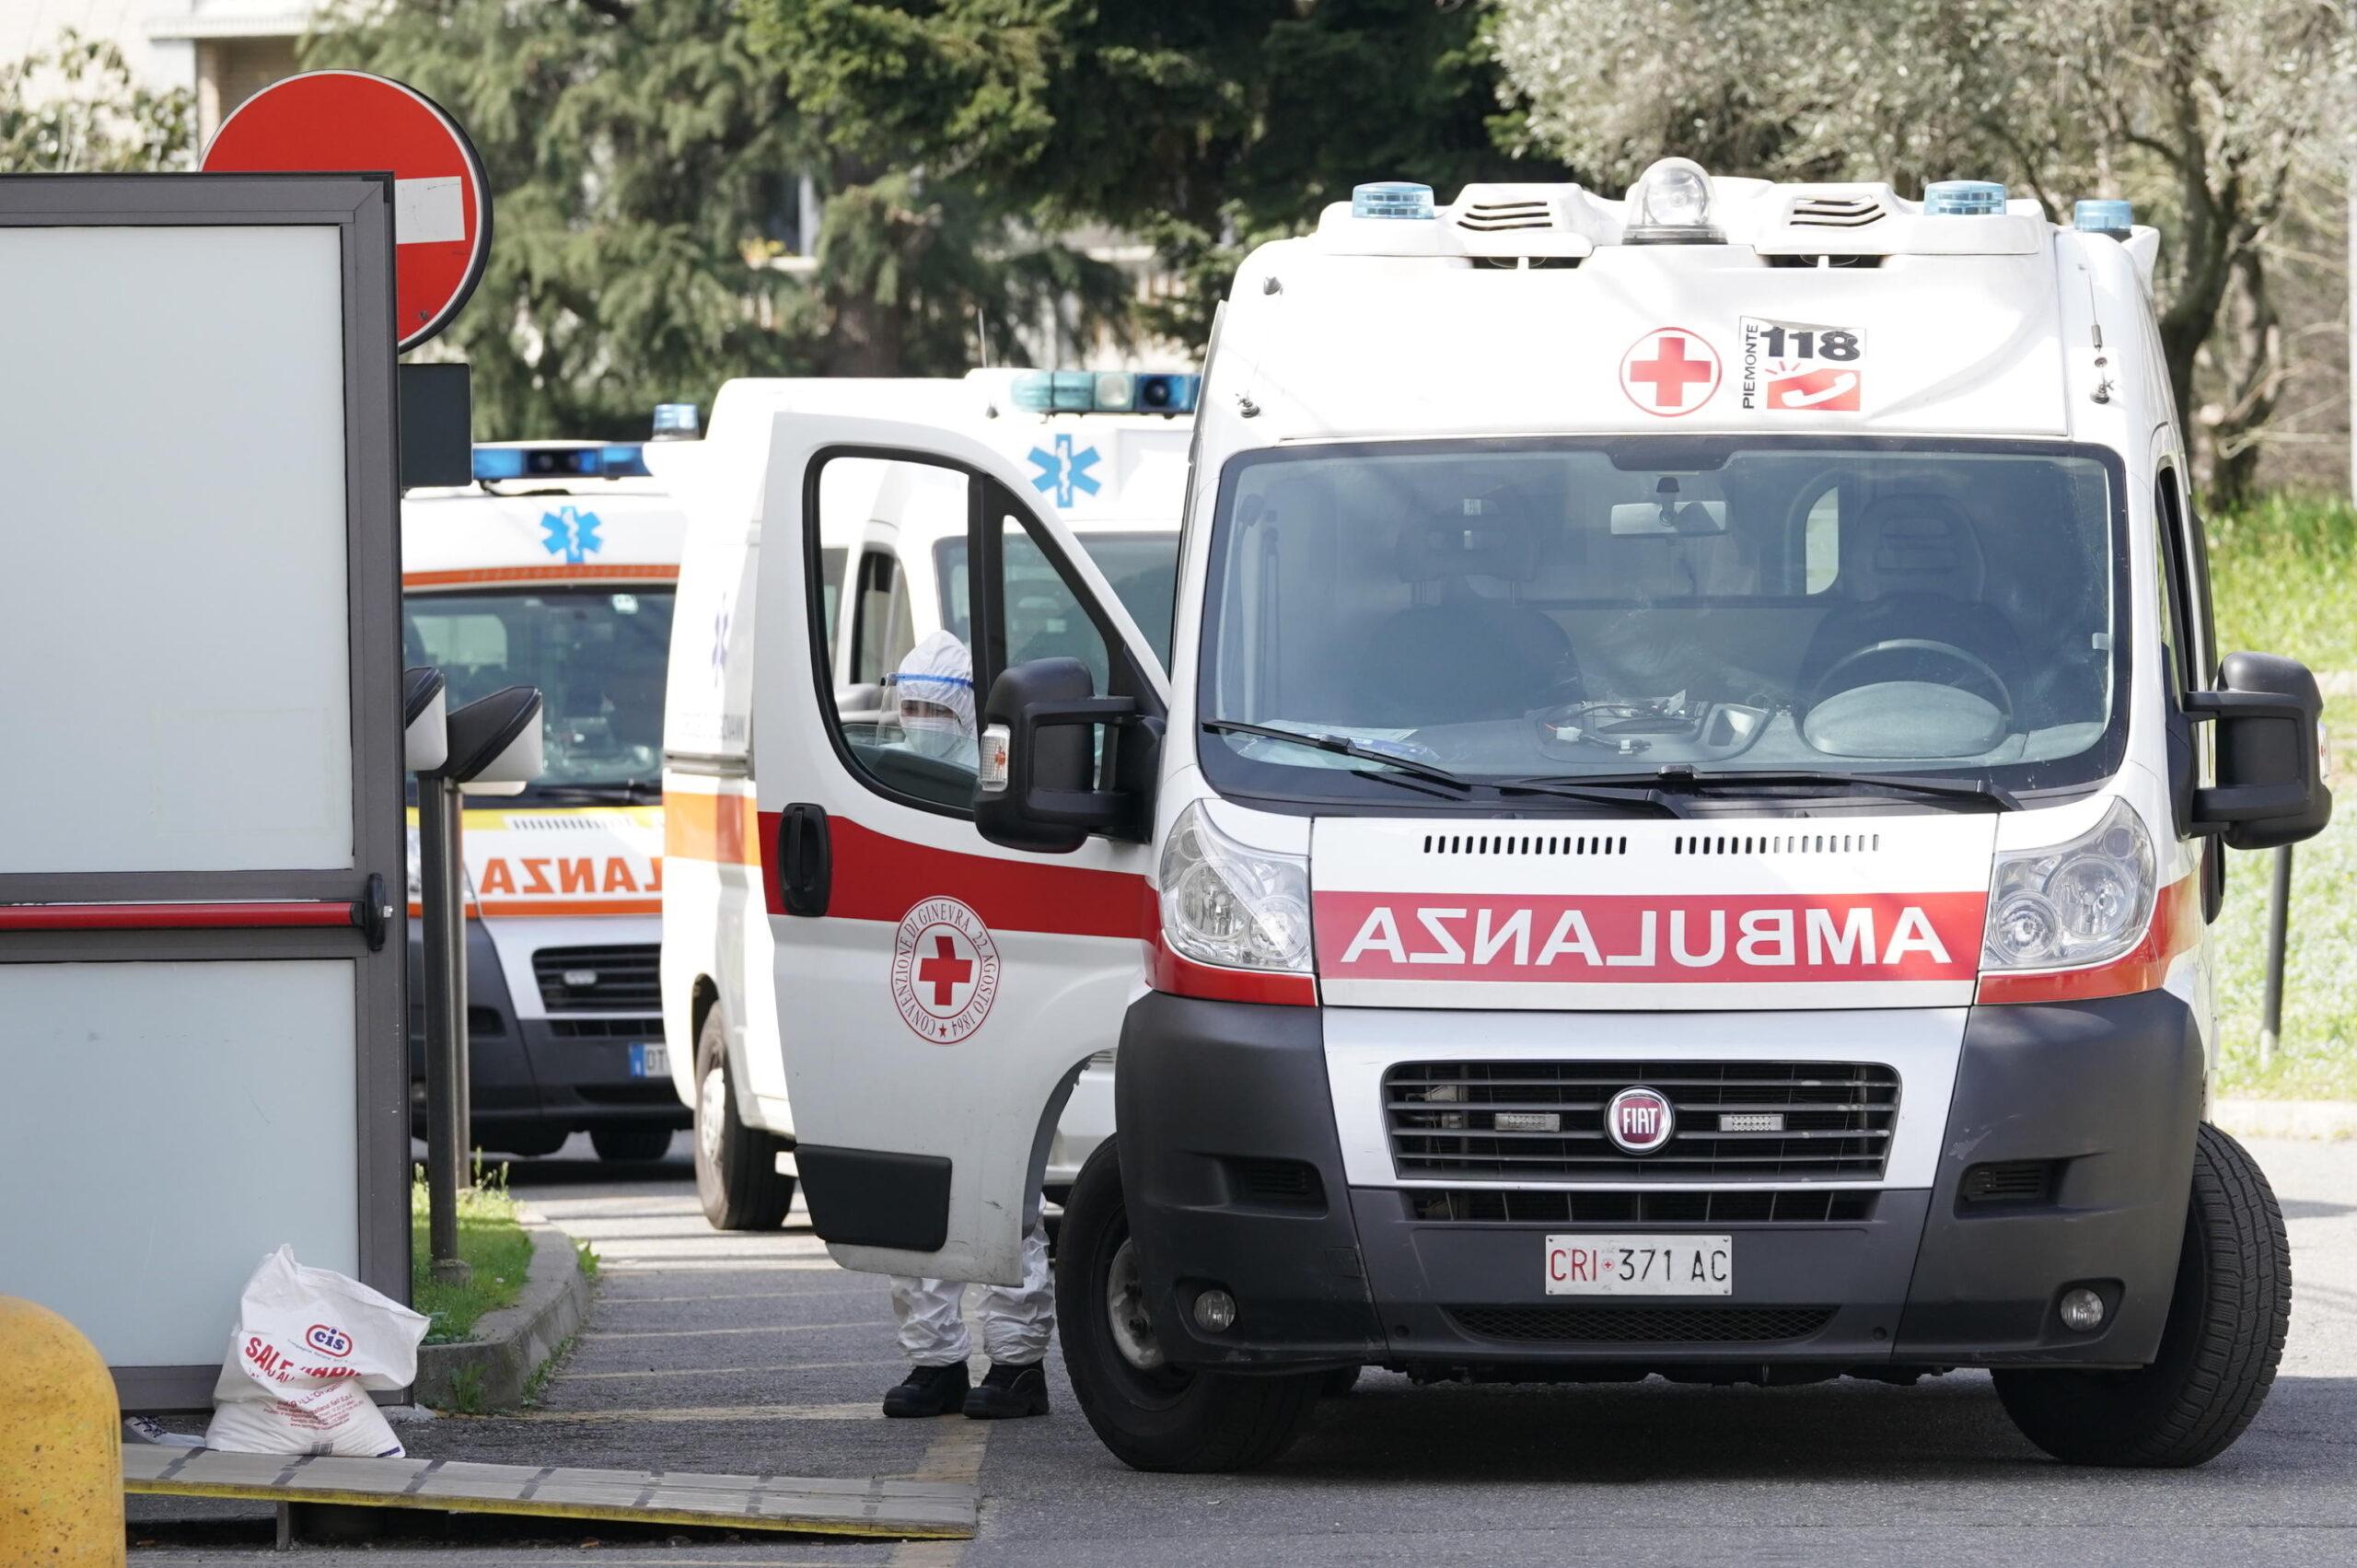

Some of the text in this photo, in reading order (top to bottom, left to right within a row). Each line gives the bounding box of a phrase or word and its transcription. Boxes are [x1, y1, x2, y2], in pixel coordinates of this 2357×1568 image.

[1760, 325, 1861, 362] 118
[1742, 323, 1759, 410] PIEMONTE
[895, 902, 996, 1037] CONVENZIONE DI GINEVRA 22 AGOSTO 1864
[1622, 1107, 1658, 1134] FIAT
[1550, 1249, 1727, 1282] CRI 371 AC
